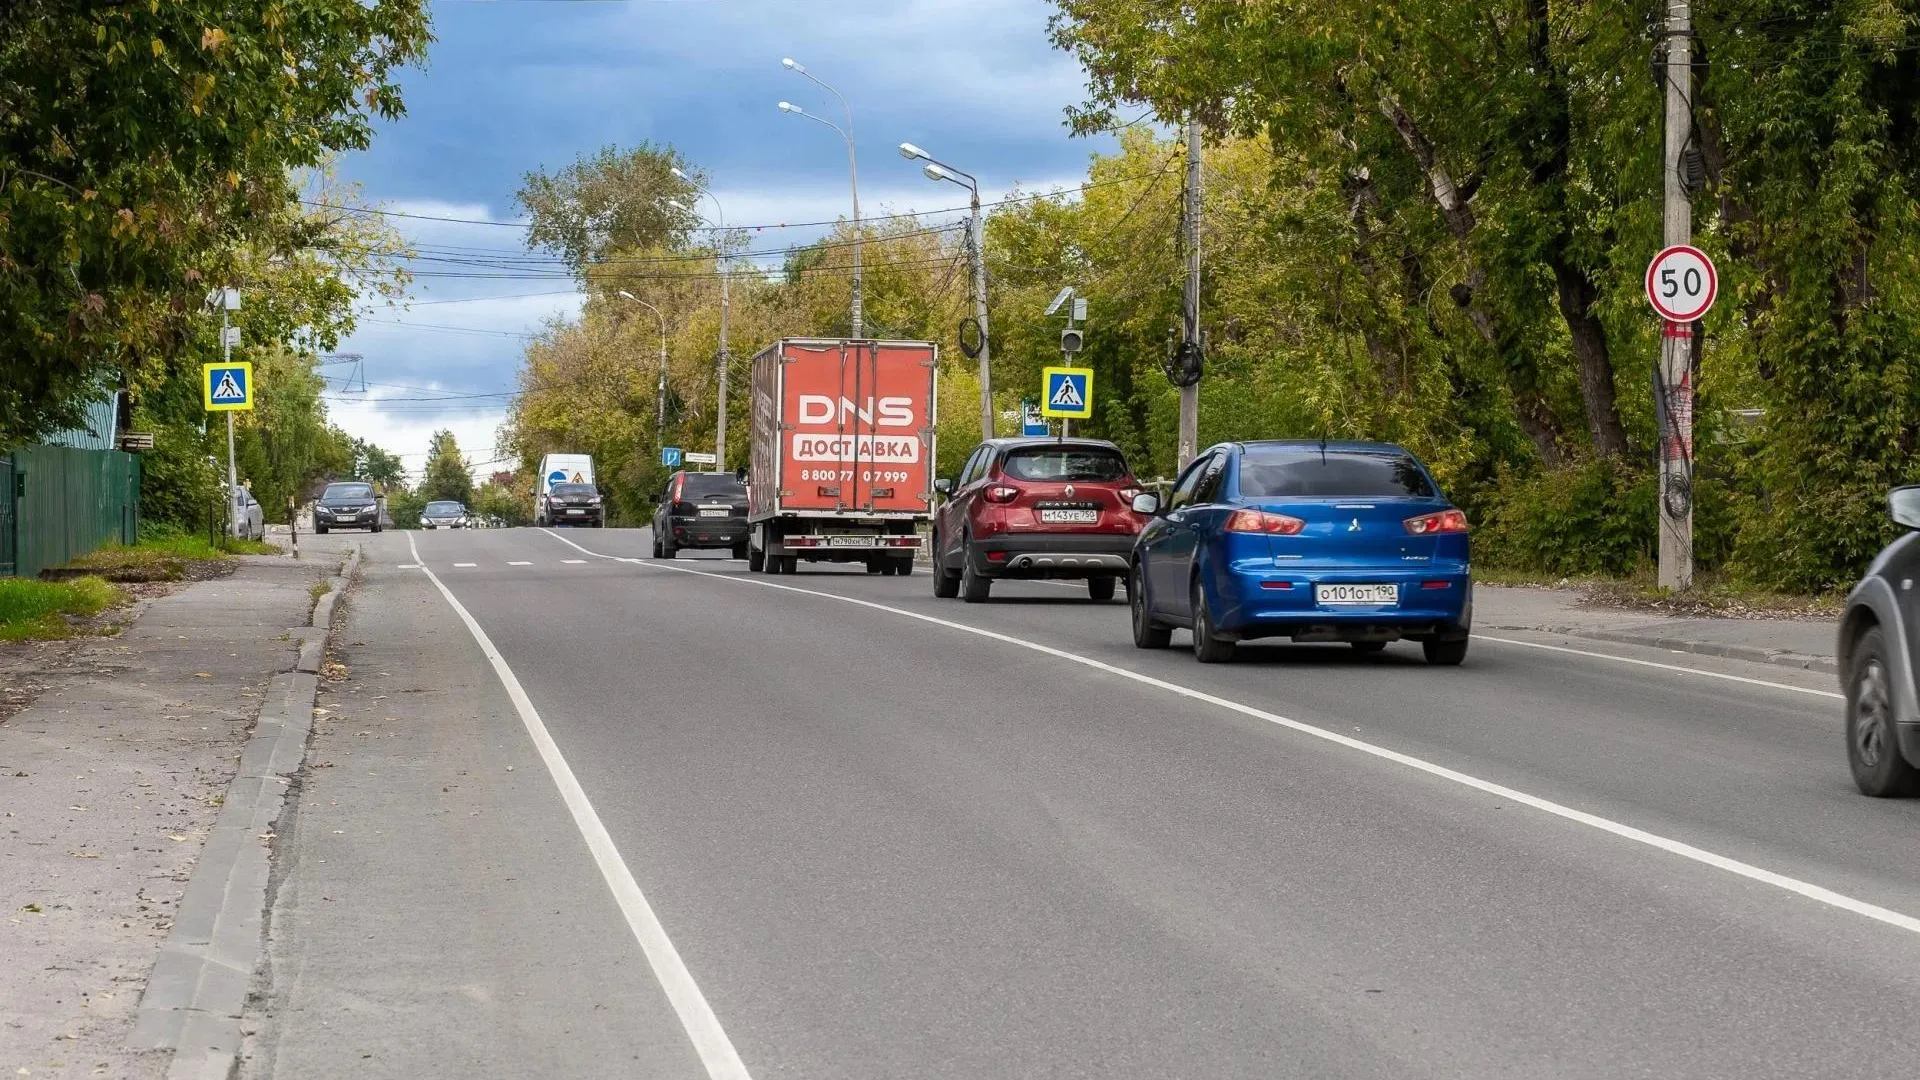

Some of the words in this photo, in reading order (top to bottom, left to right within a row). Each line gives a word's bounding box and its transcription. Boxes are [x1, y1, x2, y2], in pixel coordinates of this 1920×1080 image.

[1661, 267, 1702, 298] 50
[799, 395, 914, 426] DNS
[798, 439, 913, 458] ДОСТАВКА
[801, 469, 810, 481] 8
[812, 470, 836, 481] 800
[884, 471, 908, 483] 999
